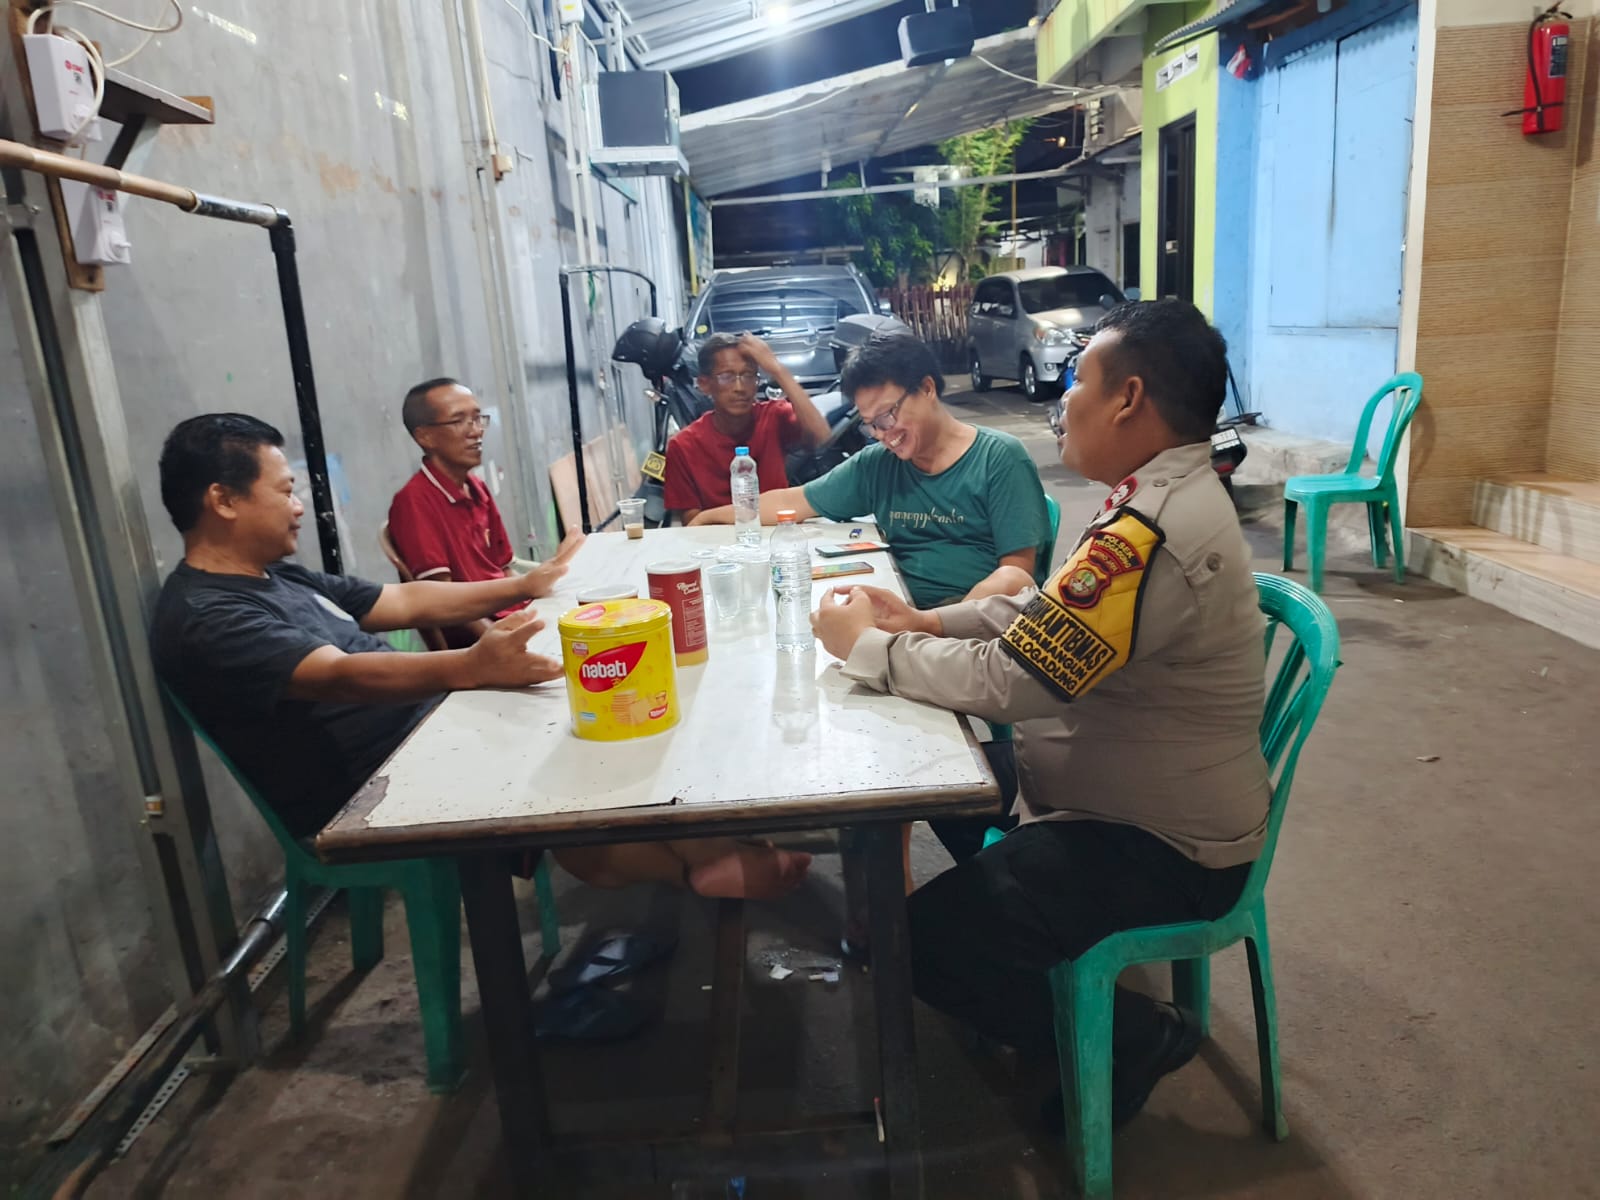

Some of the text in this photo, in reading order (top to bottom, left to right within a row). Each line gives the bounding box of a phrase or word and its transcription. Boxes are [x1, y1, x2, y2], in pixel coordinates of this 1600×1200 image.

[582, 660, 627, 678] nabati
[1007, 629, 1077, 690] PULOGADUNG
[1016, 619, 1087, 680] RAWAMANGUN
